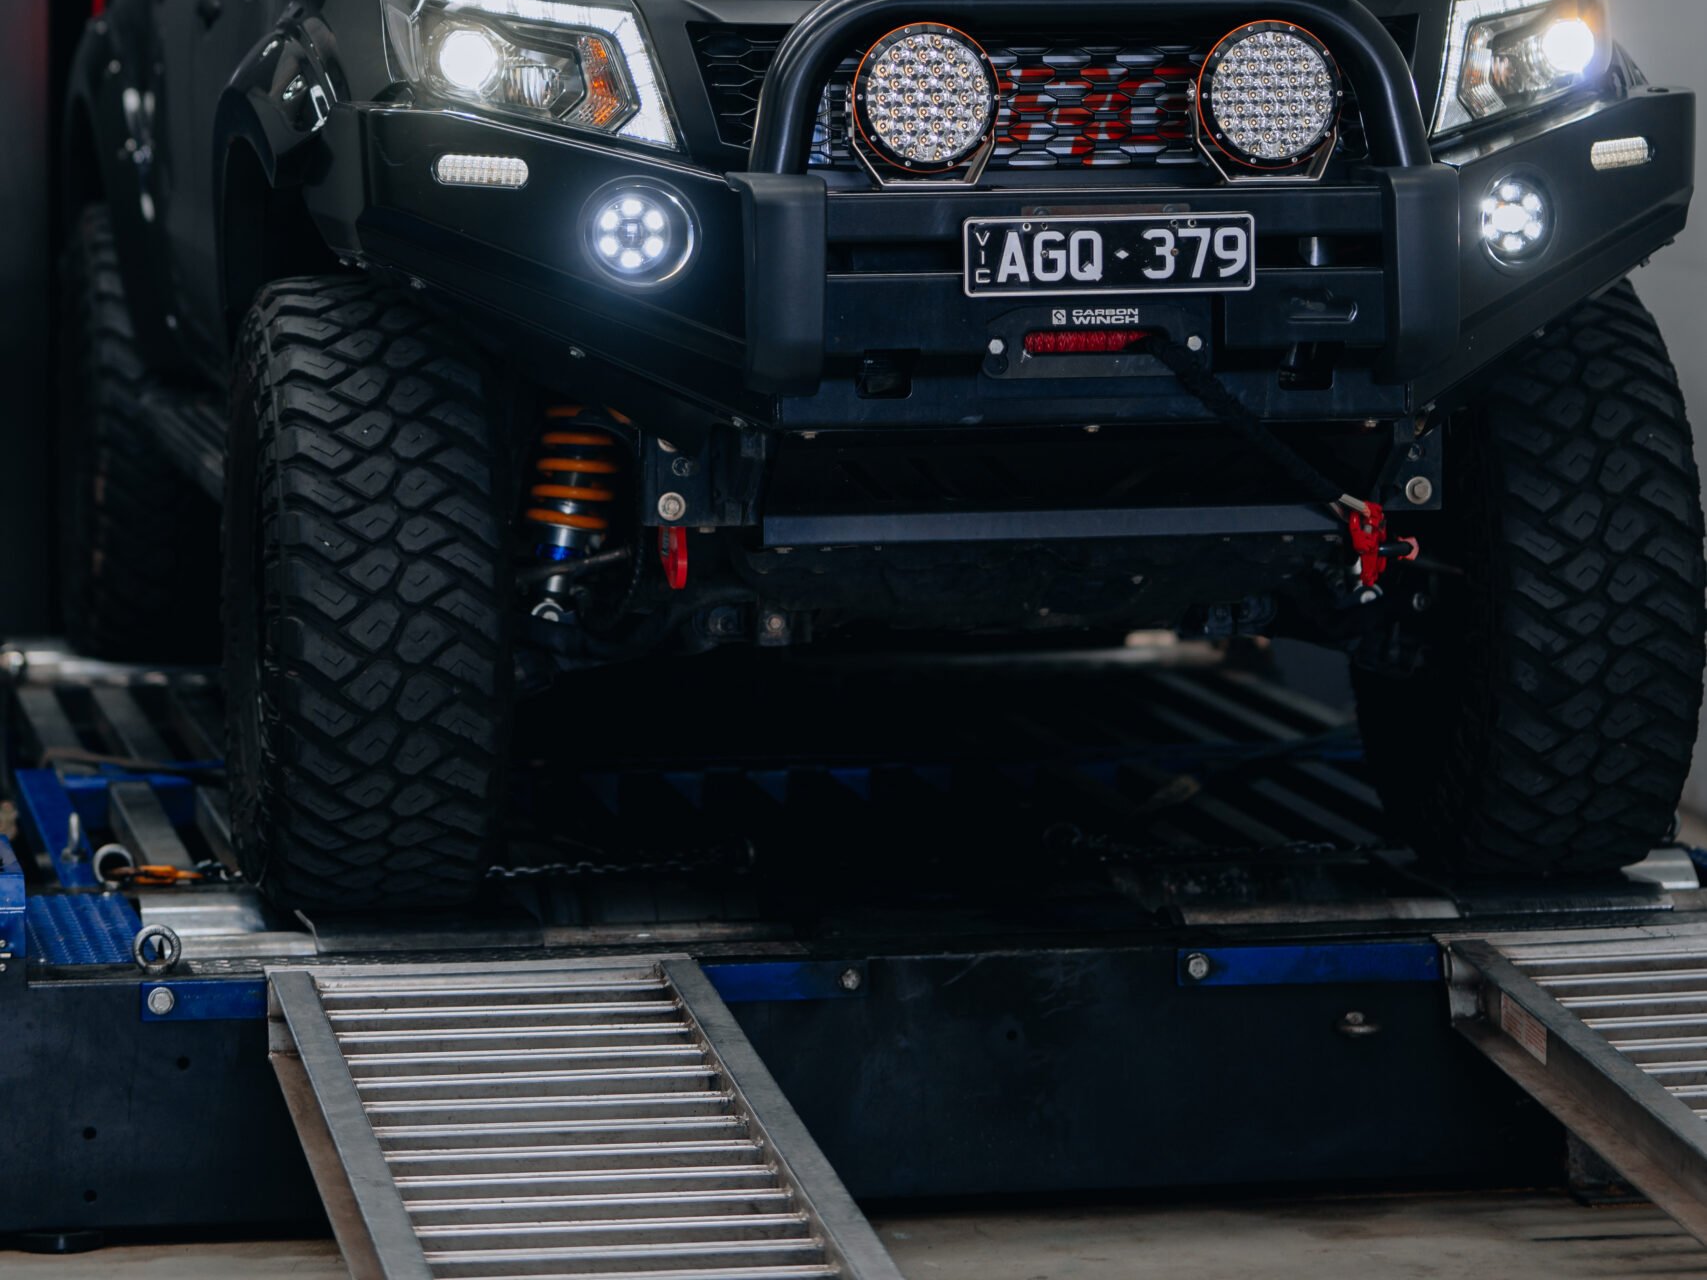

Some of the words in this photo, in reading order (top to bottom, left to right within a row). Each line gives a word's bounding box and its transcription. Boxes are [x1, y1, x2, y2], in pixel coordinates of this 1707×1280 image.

[997, 230, 1103, 283] AGQ
[1142, 227, 1247, 279] 379
[1072, 308, 1139, 316] CARBON
[1072, 316, 1139, 324] WINCH
